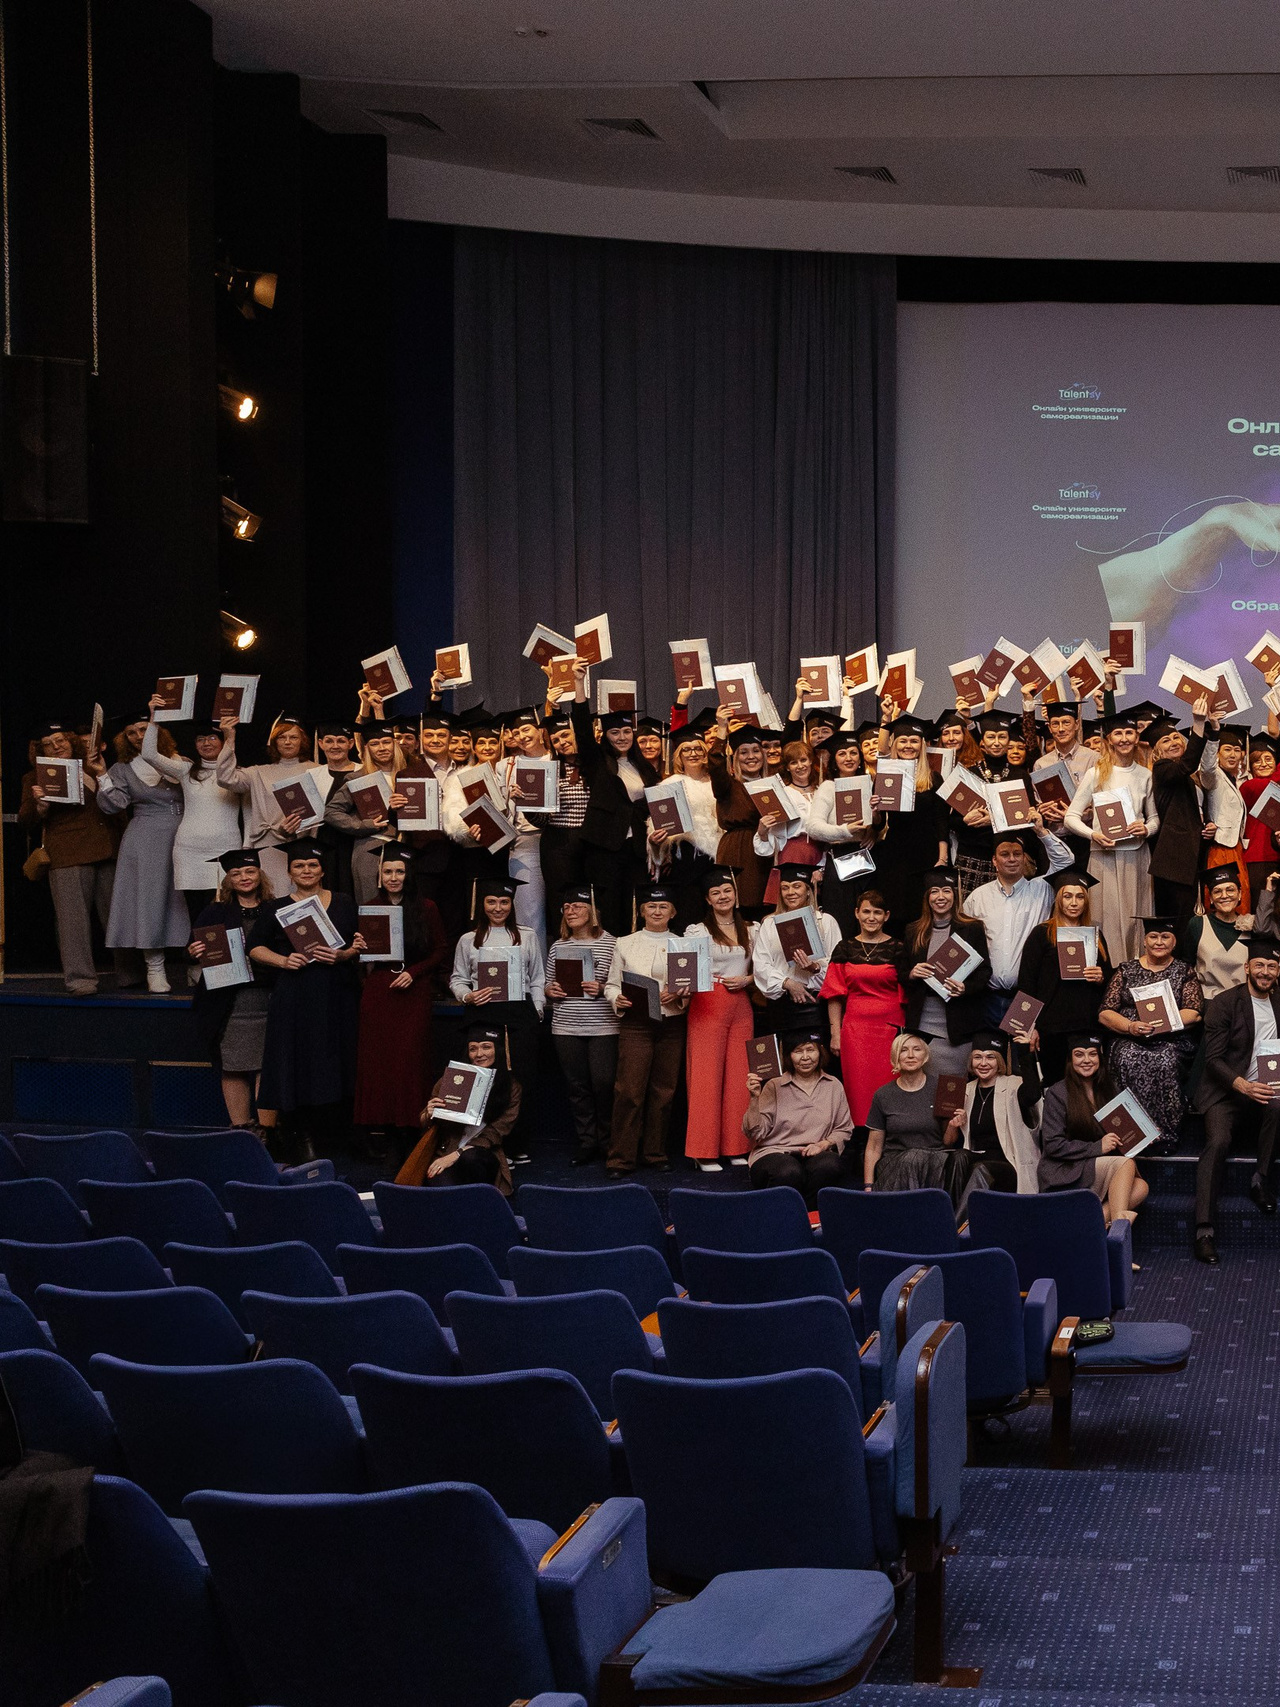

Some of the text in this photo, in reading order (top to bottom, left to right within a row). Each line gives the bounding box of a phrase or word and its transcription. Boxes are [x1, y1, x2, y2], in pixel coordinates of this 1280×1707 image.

[1059, 389, 1101, 400] Talentsy
[1032, 404, 1067, 412] Онлайн
[1059, 489, 1101, 500] Talentsy
[1032, 504, 1067, 512] Онлайн
